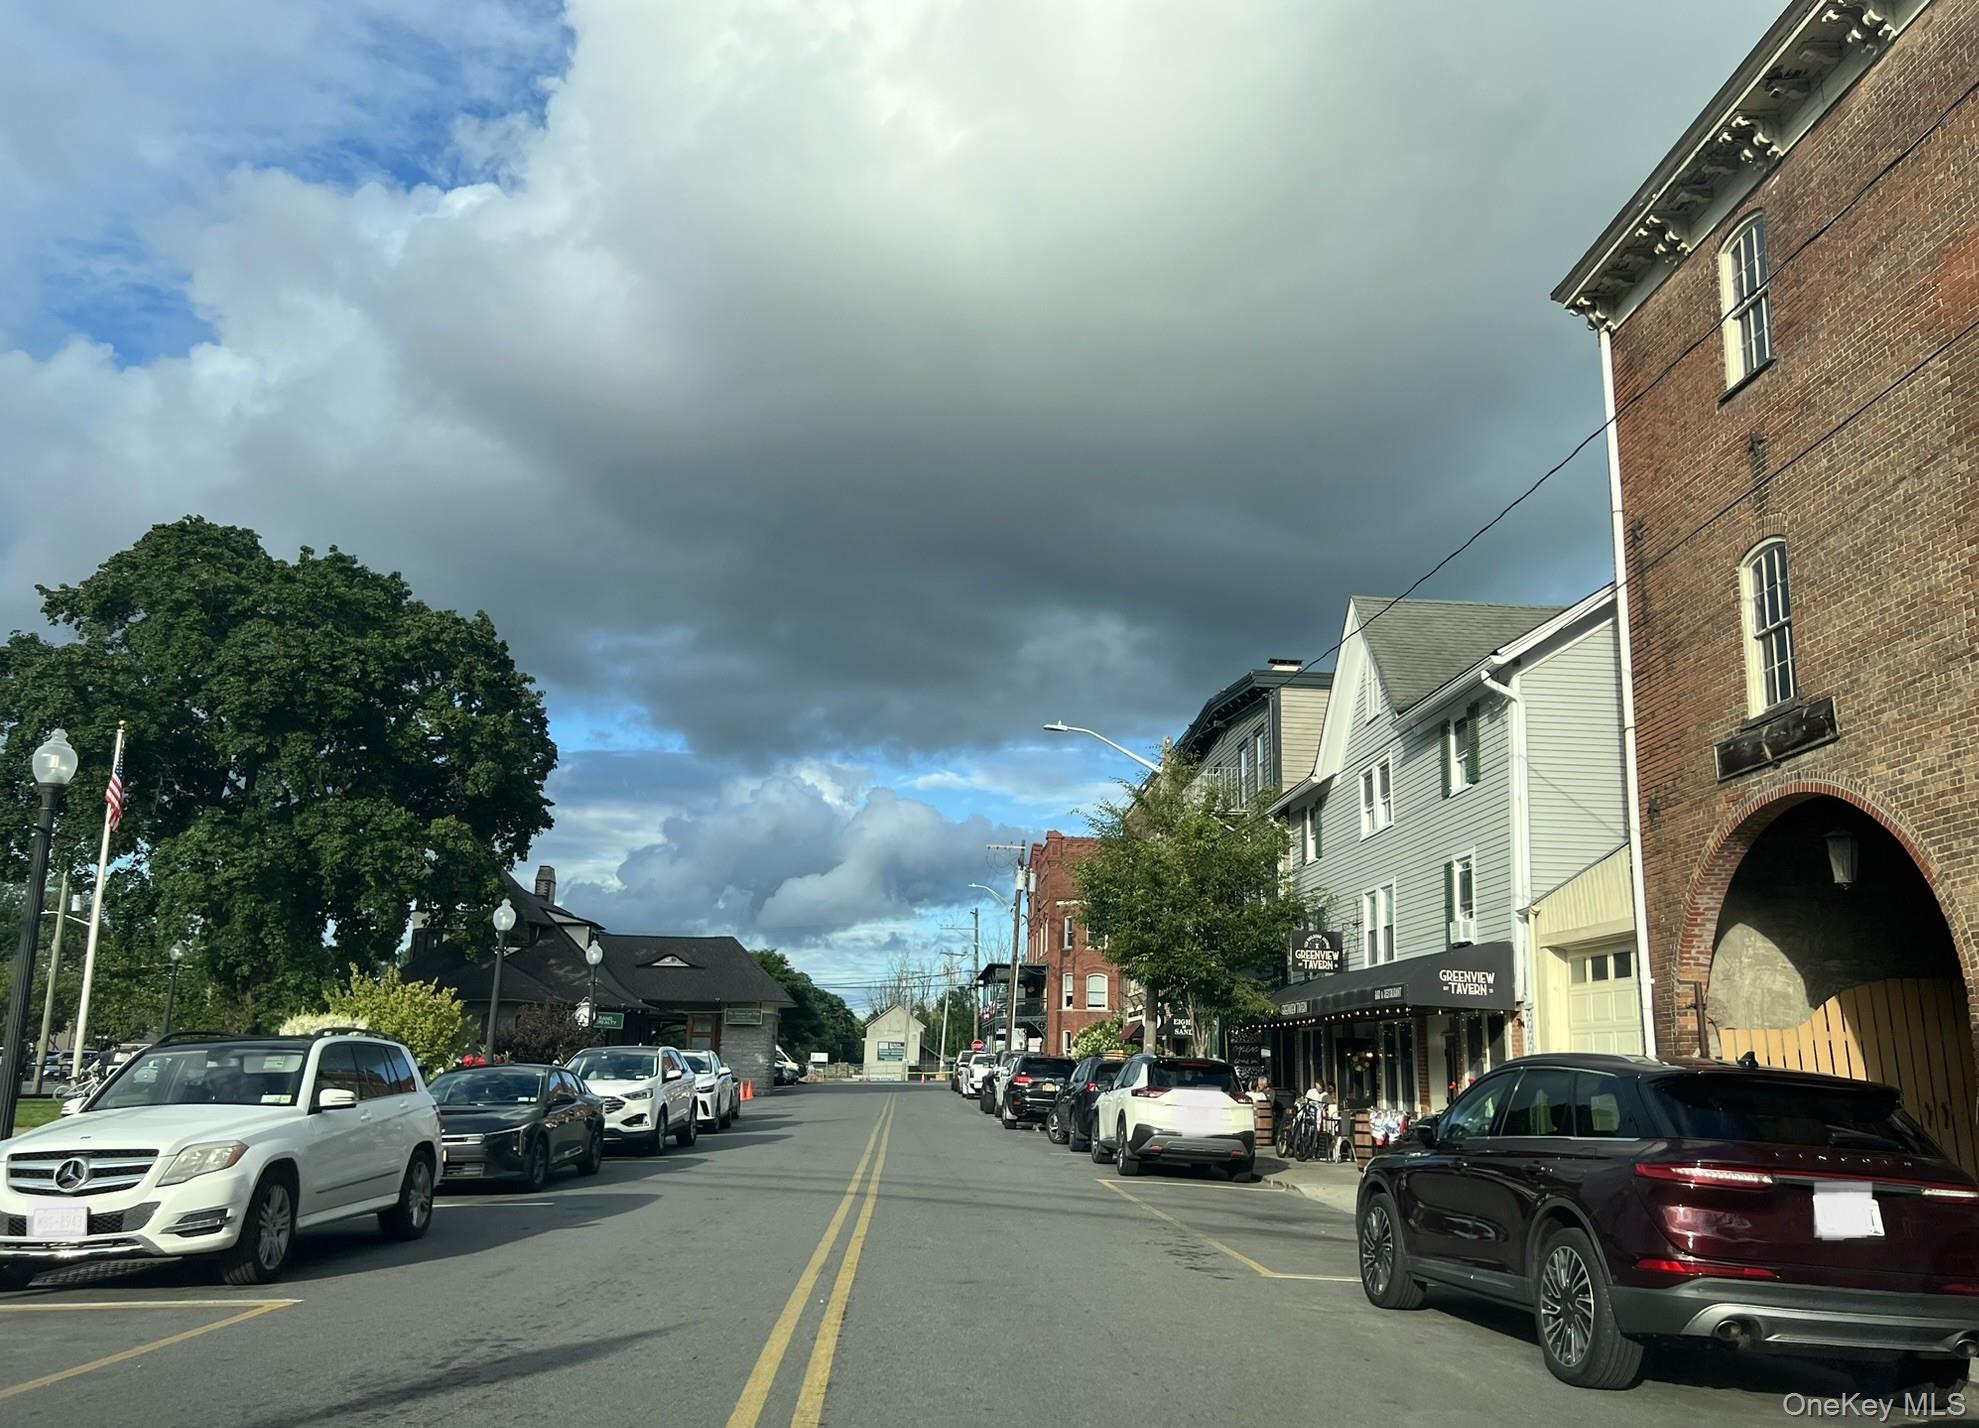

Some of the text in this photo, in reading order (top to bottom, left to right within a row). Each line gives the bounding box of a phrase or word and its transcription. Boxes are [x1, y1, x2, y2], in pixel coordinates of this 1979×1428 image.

[1295, 949, 1339, 961] GREENVIEW
[1302, 959, 1333, 970] TAVERN
[1439, 969, 1495, 985] GREENVIEW
[1448, 981, 1488, 996] TAVERN
